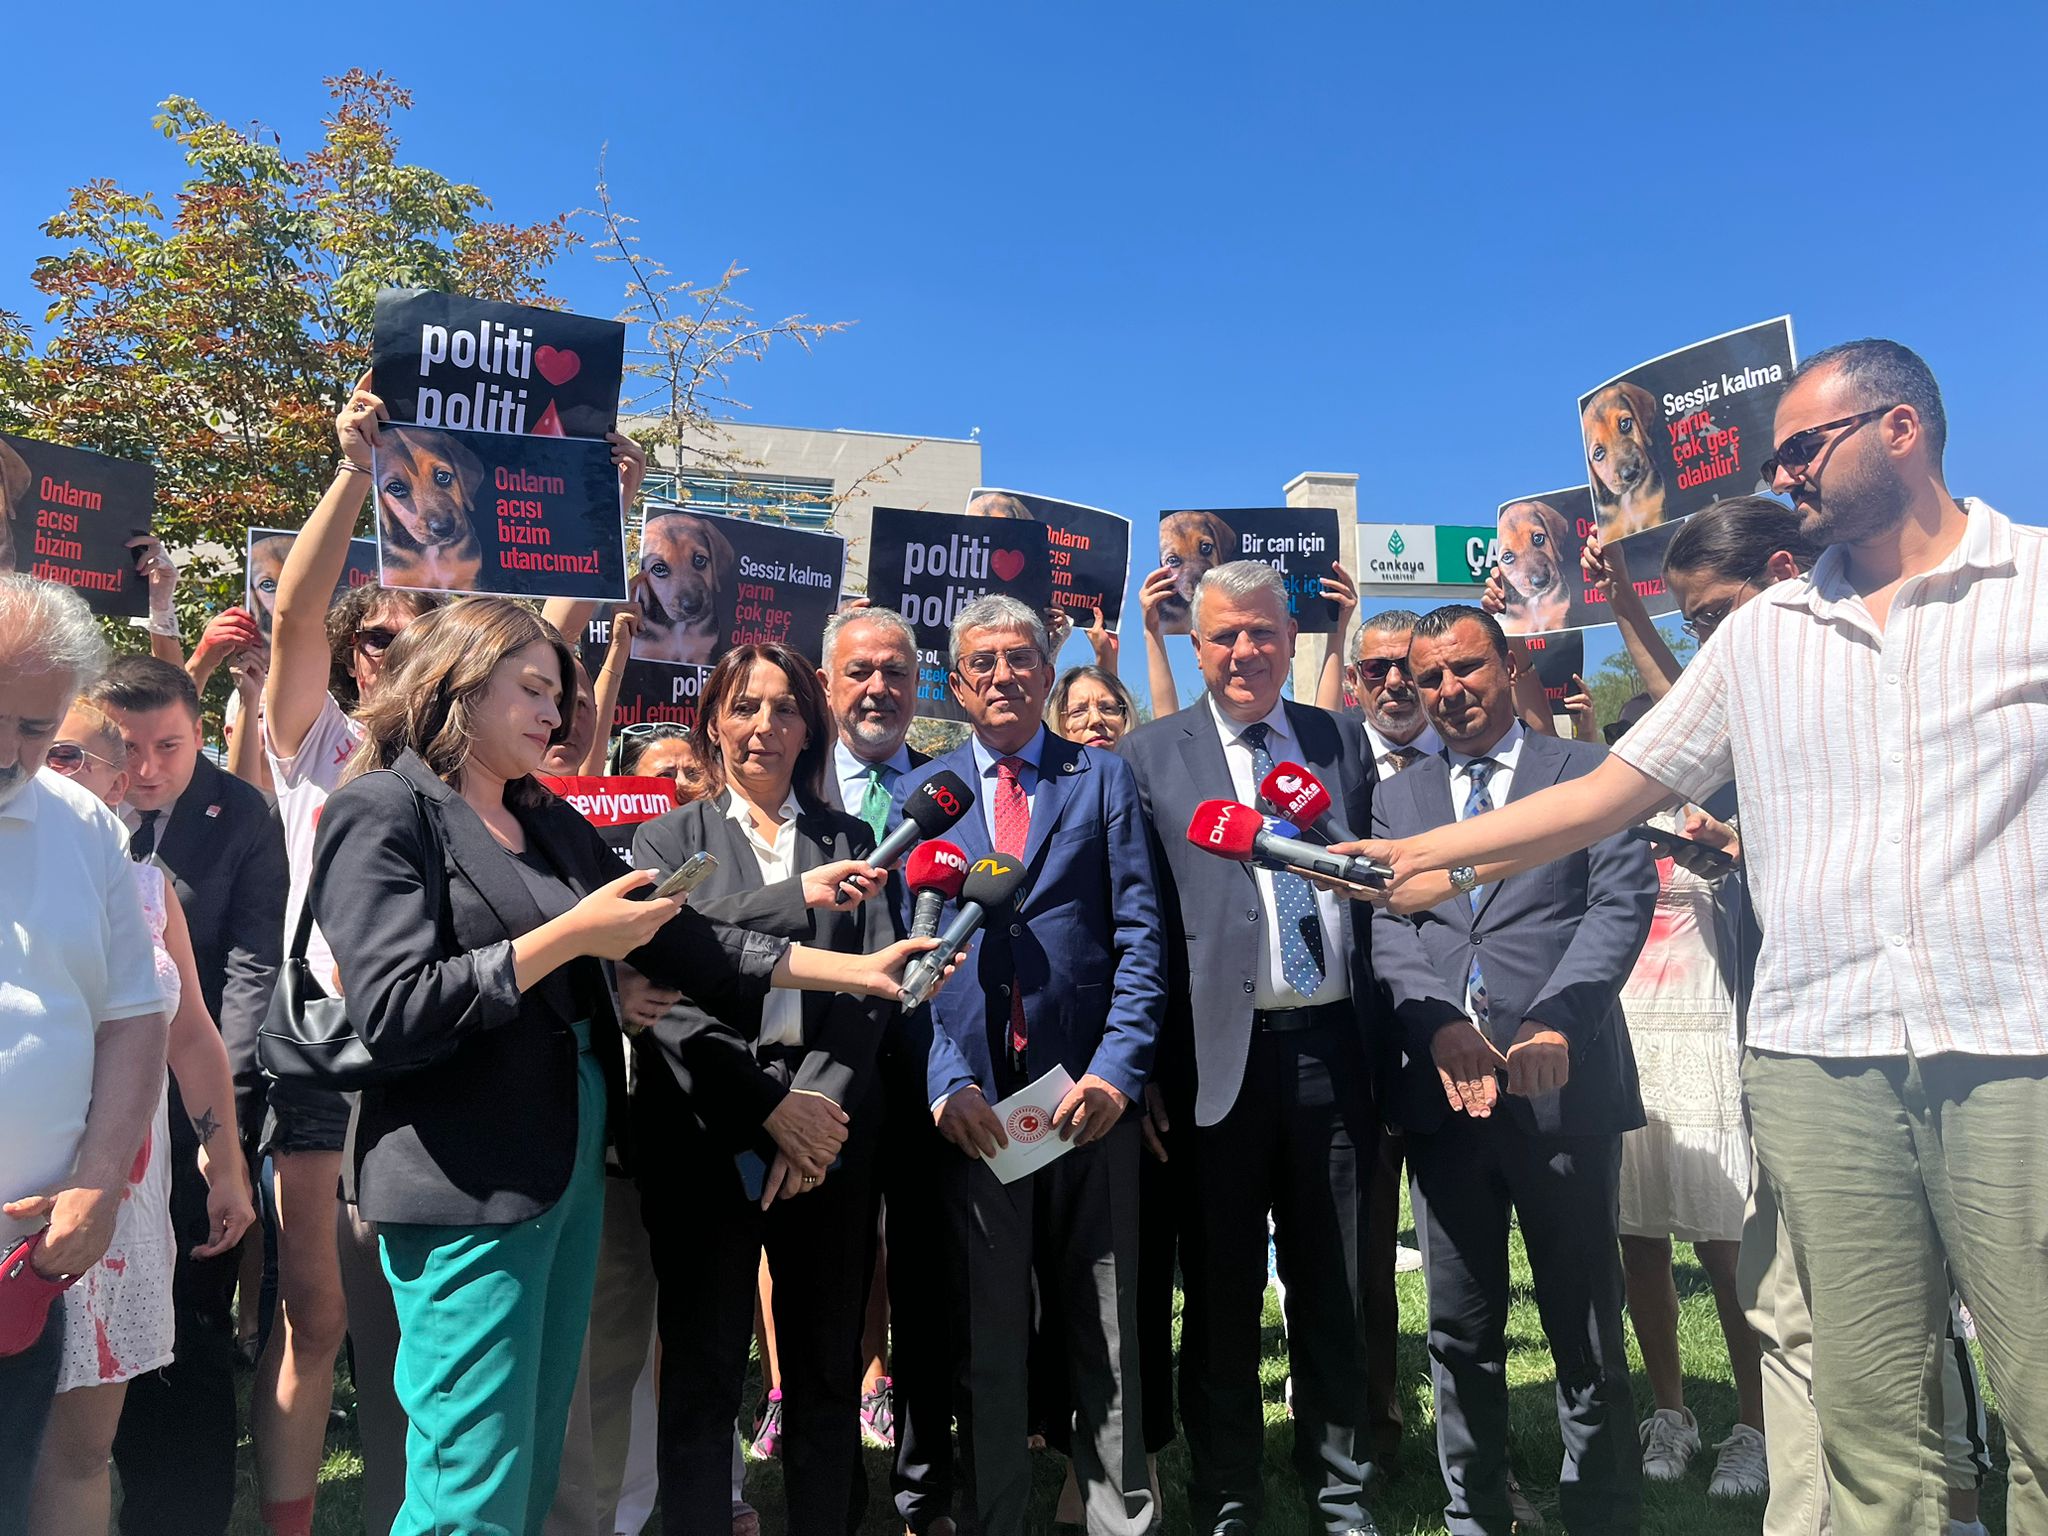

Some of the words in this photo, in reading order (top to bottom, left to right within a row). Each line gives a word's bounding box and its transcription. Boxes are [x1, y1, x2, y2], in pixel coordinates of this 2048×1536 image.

[420, 319, 533, 380] politi
[1662, 379, 1719, 416] Sessiz
[1721, 363, 1783, 396] kalma
[416, 382, 528, 434] politi
[1667, 410, 1711, 445] yarın
[1672, 434, 1704, 469] çok
[1706, 425, 1740, 456] geç
[494, 465, 565, 496] Onların
[1677, 448, 1741, 490] olabilir!
[39, 475, 102, 511] Onların
[496, 498, 543, 519] acısı
[36, 508, 79, 534] acısı
[497, 518, 551, 546] bizim
[34, 529, 82, 561] bizim
[500, 546, 600, 574] utancımız!
[903, 533, 990, 585] politi
[1242, 533, 1264, 553] Bir
[1267, 537, 1294, 553] can
[1298, 531, 1325, 557] için
[31, 559, 123, 593] utancımız!
[739, 555, 787, 582] Sessiz
[789, 562, 832, 589] kalma
[1370, 559, 1424, 574] Çankaya
[737, 582, 775, 602] yarın
[735, 600, 762, 625] çok
[764, 606, 792, 632] geç
[565, 787, 671, 822] seviyorum
[1289, 782, 1320, 811] anka
